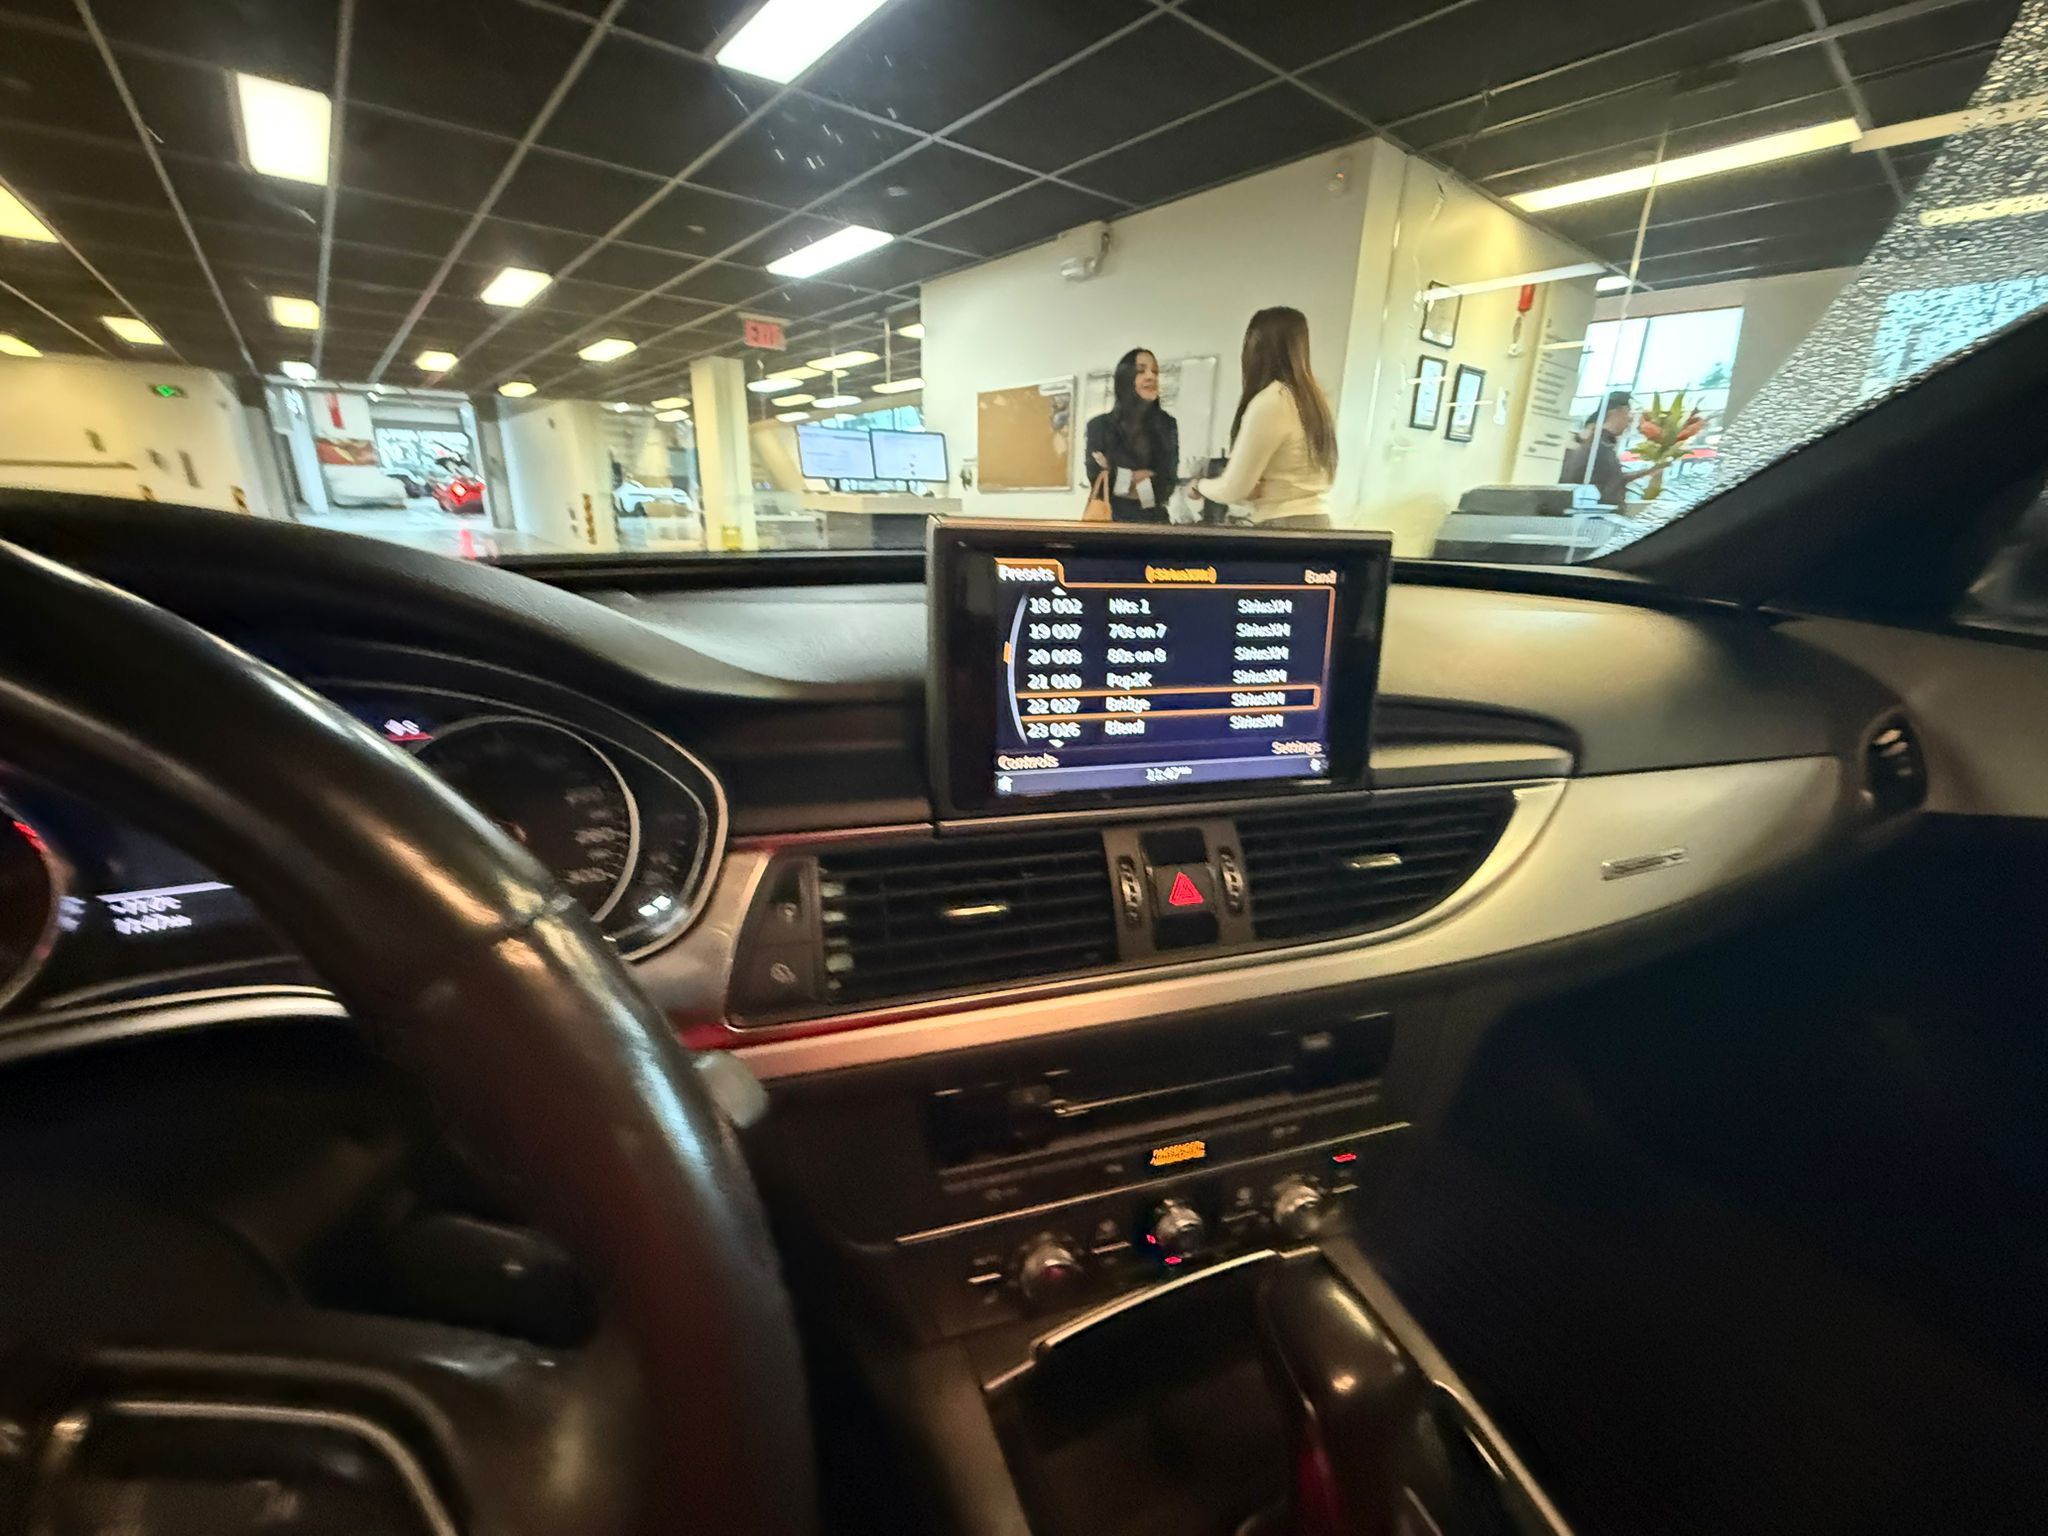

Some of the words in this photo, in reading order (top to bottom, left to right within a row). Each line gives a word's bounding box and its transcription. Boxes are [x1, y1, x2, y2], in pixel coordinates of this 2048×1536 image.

[998, 564, 1056, 582] Presets
[1109, 598, 1139, 614] Hits
[1140, 598, 1151, 614] 1
[1237, 599, 1293, 614] SiriusXM
[1029, 623, 1051, 640] 19
[1051, 623, 1082, 640] 007
[1108, 623, 1136, 639] 70s
[1135, 626, 1156, 639] on
[1155, 623, 1167, 639] 7
[1236, 622, 1291, 637] SiriusXM
[1027, 648, 1050, 665] 20
[1107, 648, 1135, 664] 80s
[1134, 650, 1155, 663] on
[1154, 647, 1167, 663] 8
[1234, 646, 1289, 661] SiriusXM
[1027, 674, 1050, 690] 21
[1232, 669, 1287, 684] SiriusXM
[1027, 699, 1050, 715] 22
[1105, 695, 1152, 714] Bridge
[1231, 691, 1286, 707] SiriusXM
[1027, 723, 1049, 739] 23
[1229, 713, 1284, 730] SiriusXM
[1271, 740, 1323, 756] Settings
[998, 752, 1060, 771] Controls
